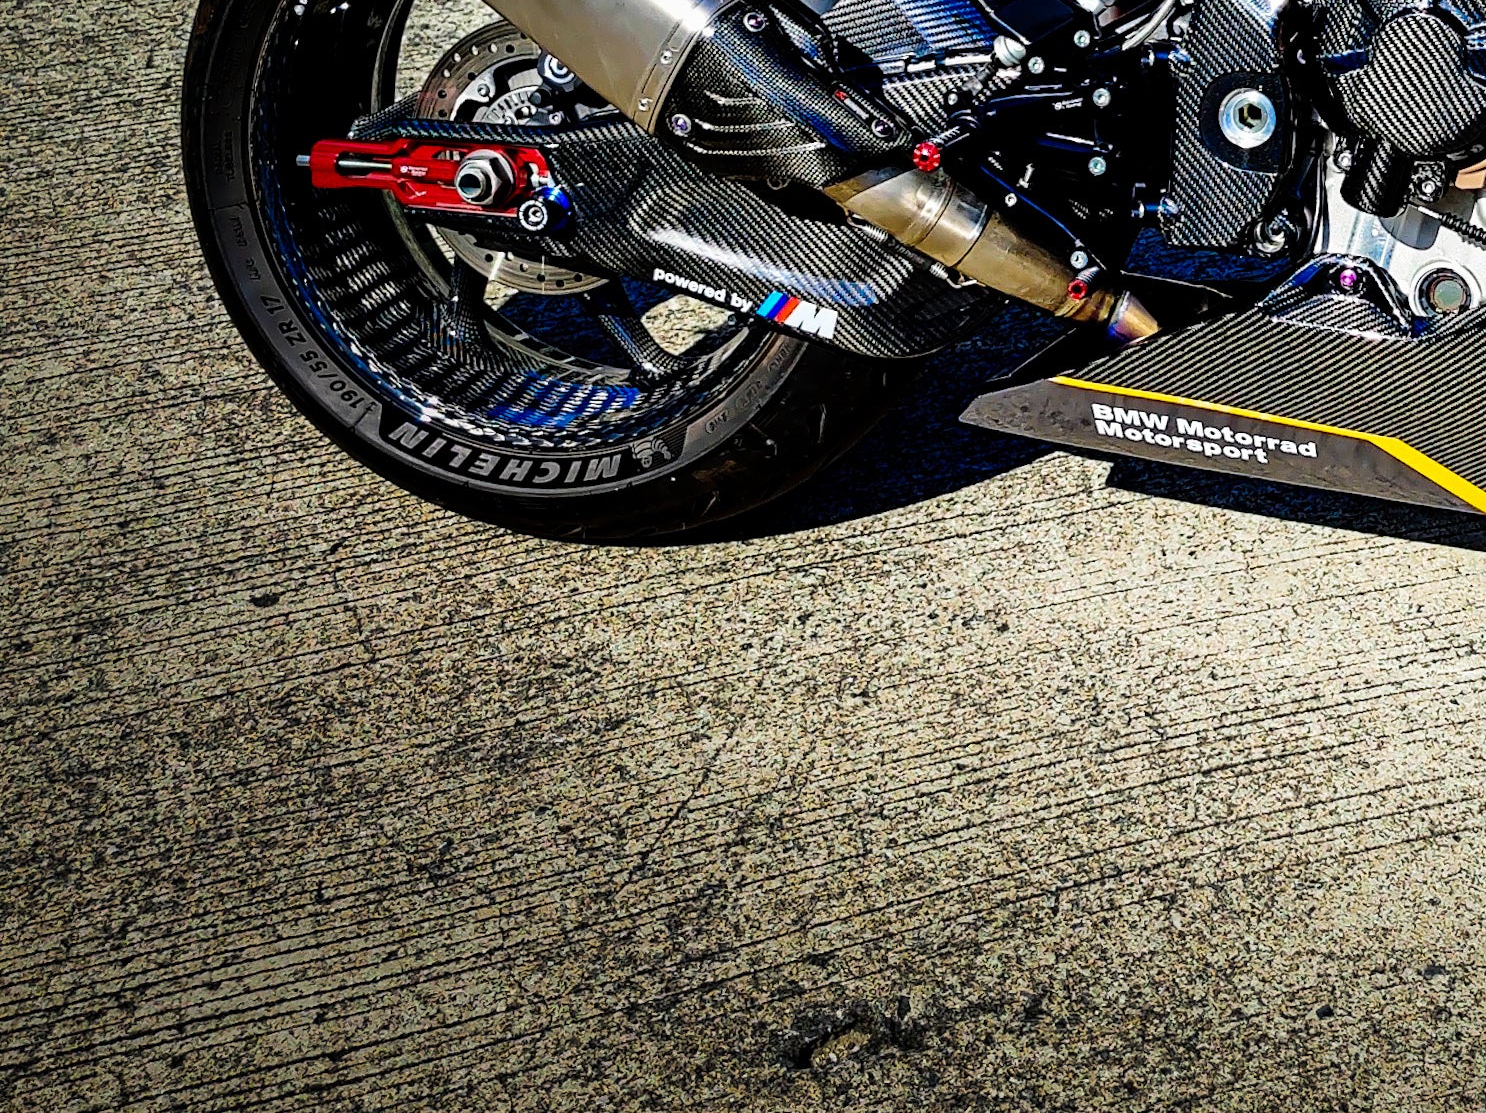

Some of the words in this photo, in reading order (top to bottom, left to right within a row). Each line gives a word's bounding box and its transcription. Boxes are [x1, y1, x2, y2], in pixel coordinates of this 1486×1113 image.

[260, 295, 285, 315] 17
[653, 268, 727, 302] powered
[730, 293, 754, 313] by
[278, 319, 307, 347] ZR
[300, 350, 365, 410] 190/55
[388, 421, 622, 484] MICHELIN
[1091, 403, 1169, 431] BMW
[1175, 418, 1318, 458] Motorrad
[1095, 419, 1269, 464] Motorsport
